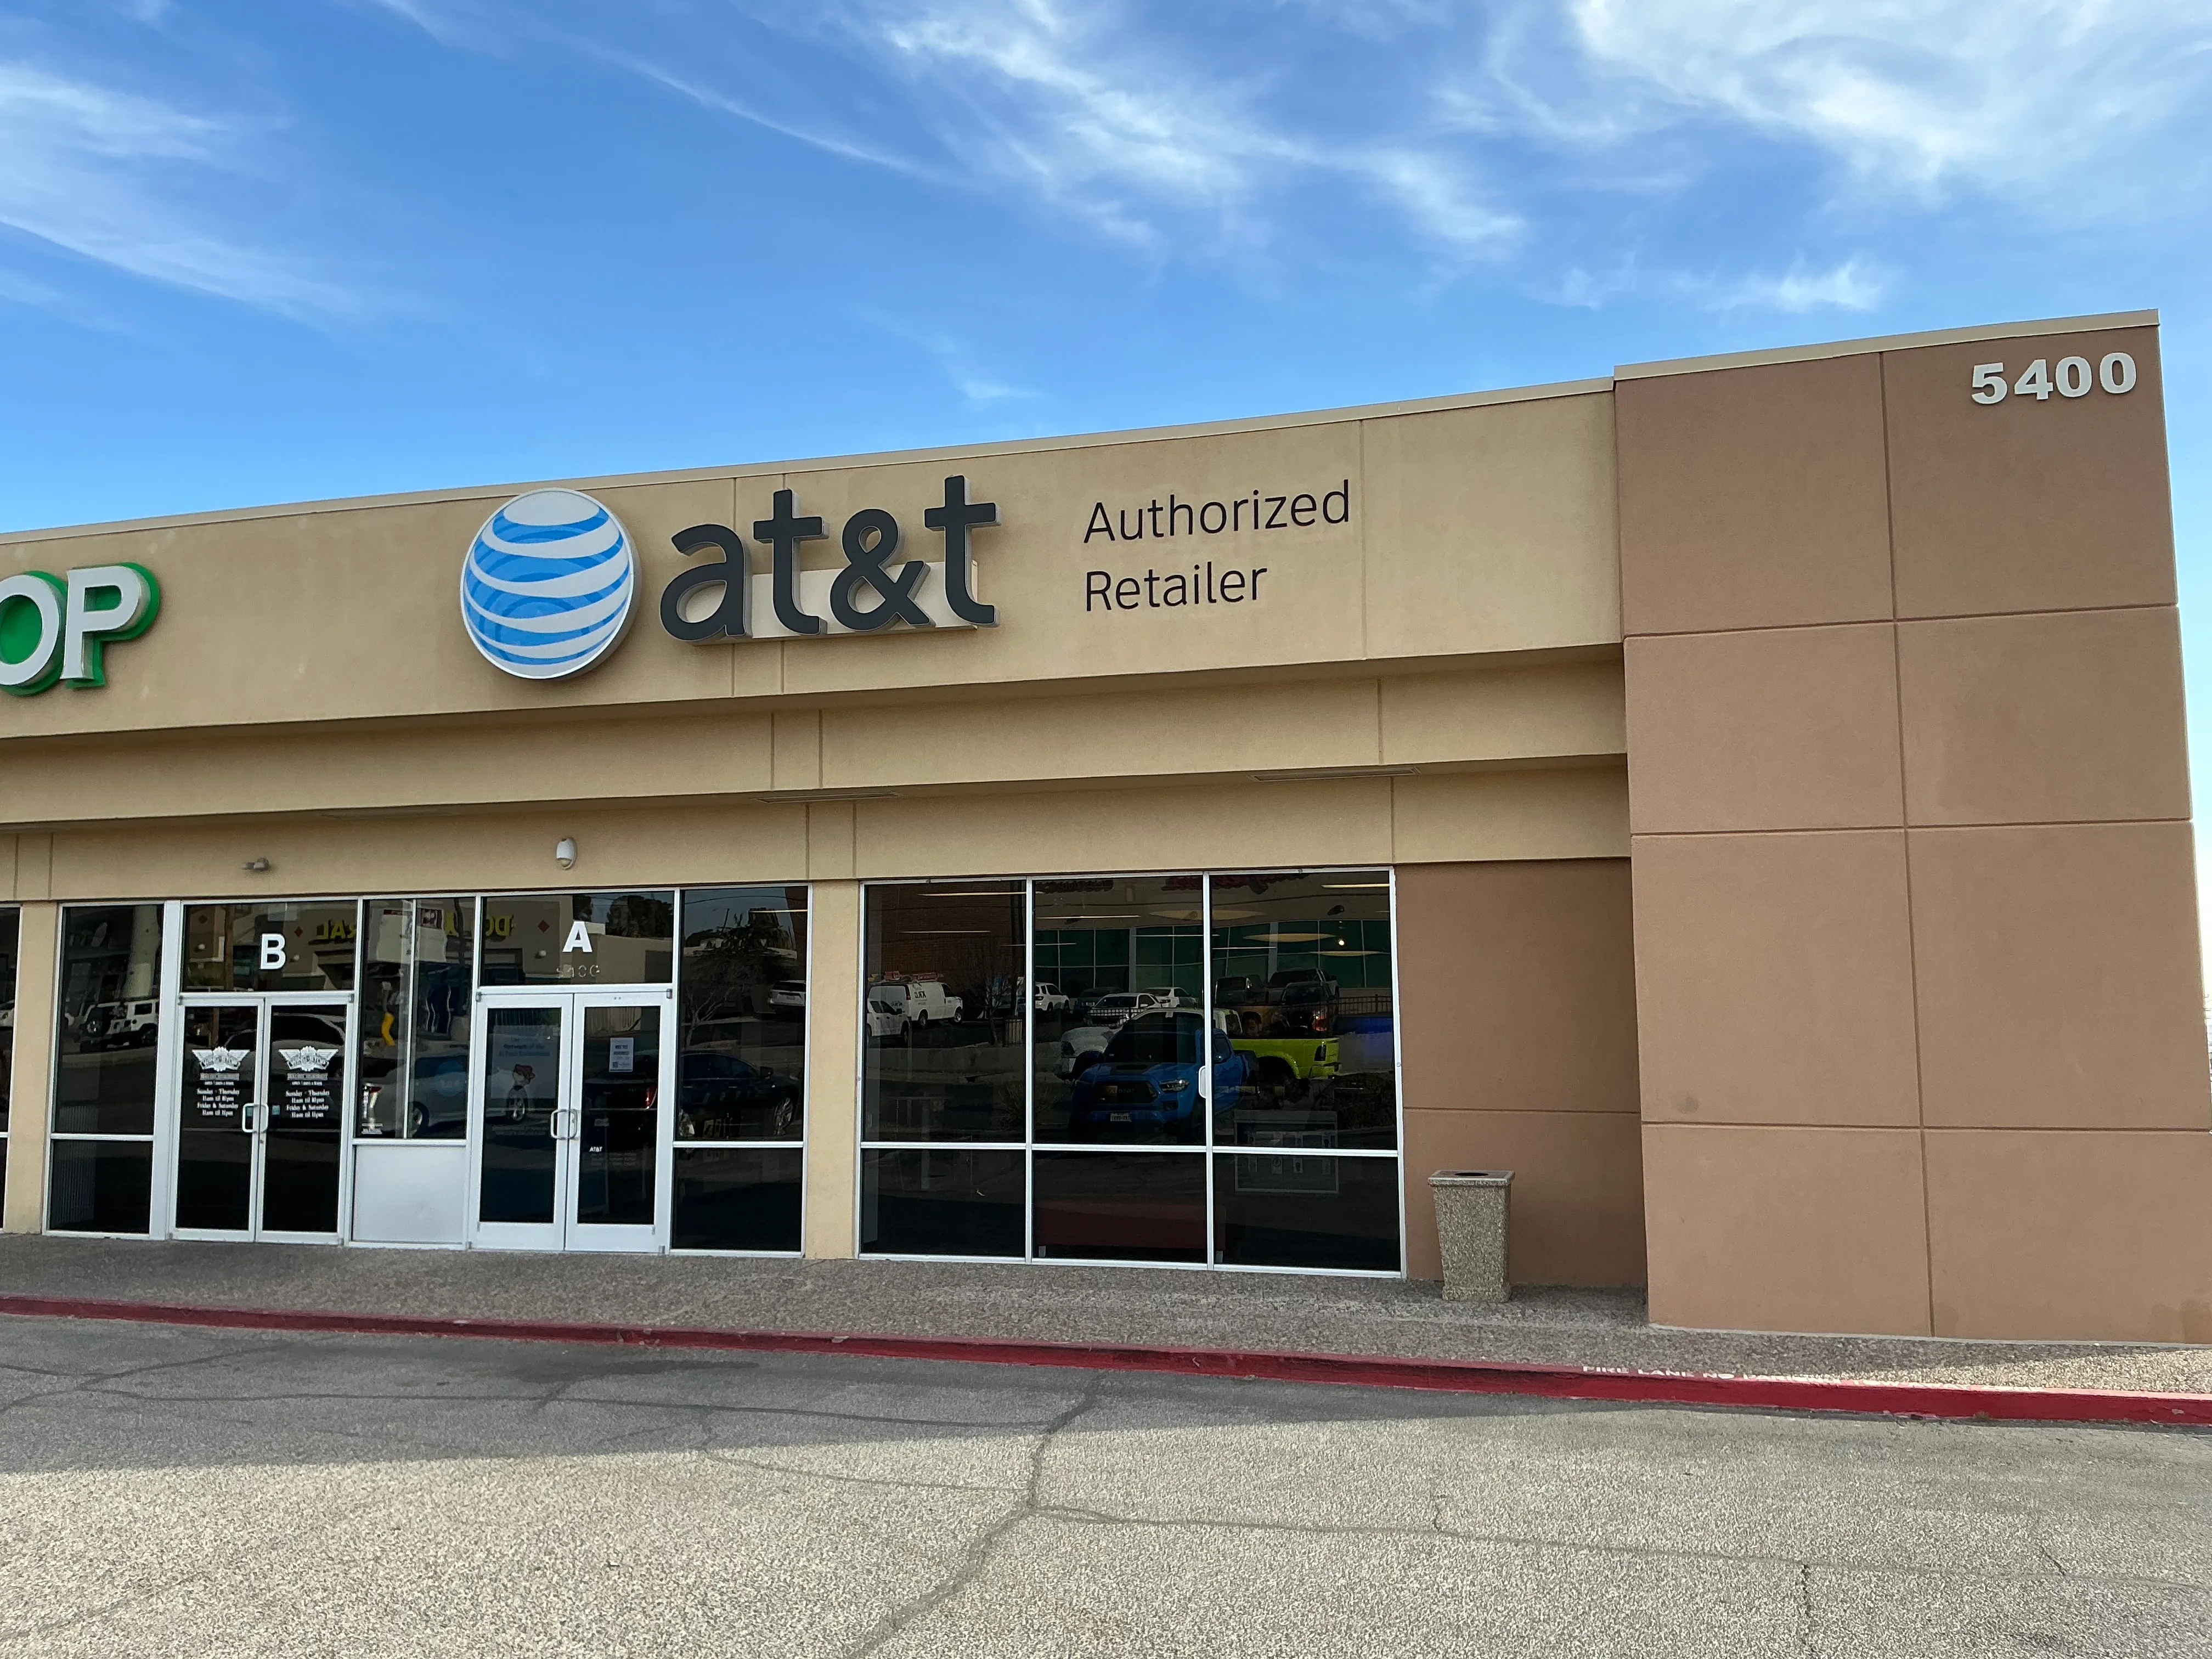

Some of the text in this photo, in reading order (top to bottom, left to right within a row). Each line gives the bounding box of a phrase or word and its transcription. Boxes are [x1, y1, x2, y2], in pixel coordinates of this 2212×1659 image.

[1971, 352, 2137, 404] 5400
[1084, 479, 1348, 543] Authorized
[660, 475, 1000, 643] at&t
[1087, 561, 1267, 611] Retailer
[0, 564, 154, 687] OP
[260, 933, 286, 970] B
[562, 921, 592, 953] A
[1583, 1365, 1629, 1374] FIRE
[1637, 1369, 1695, 1378] LANE
